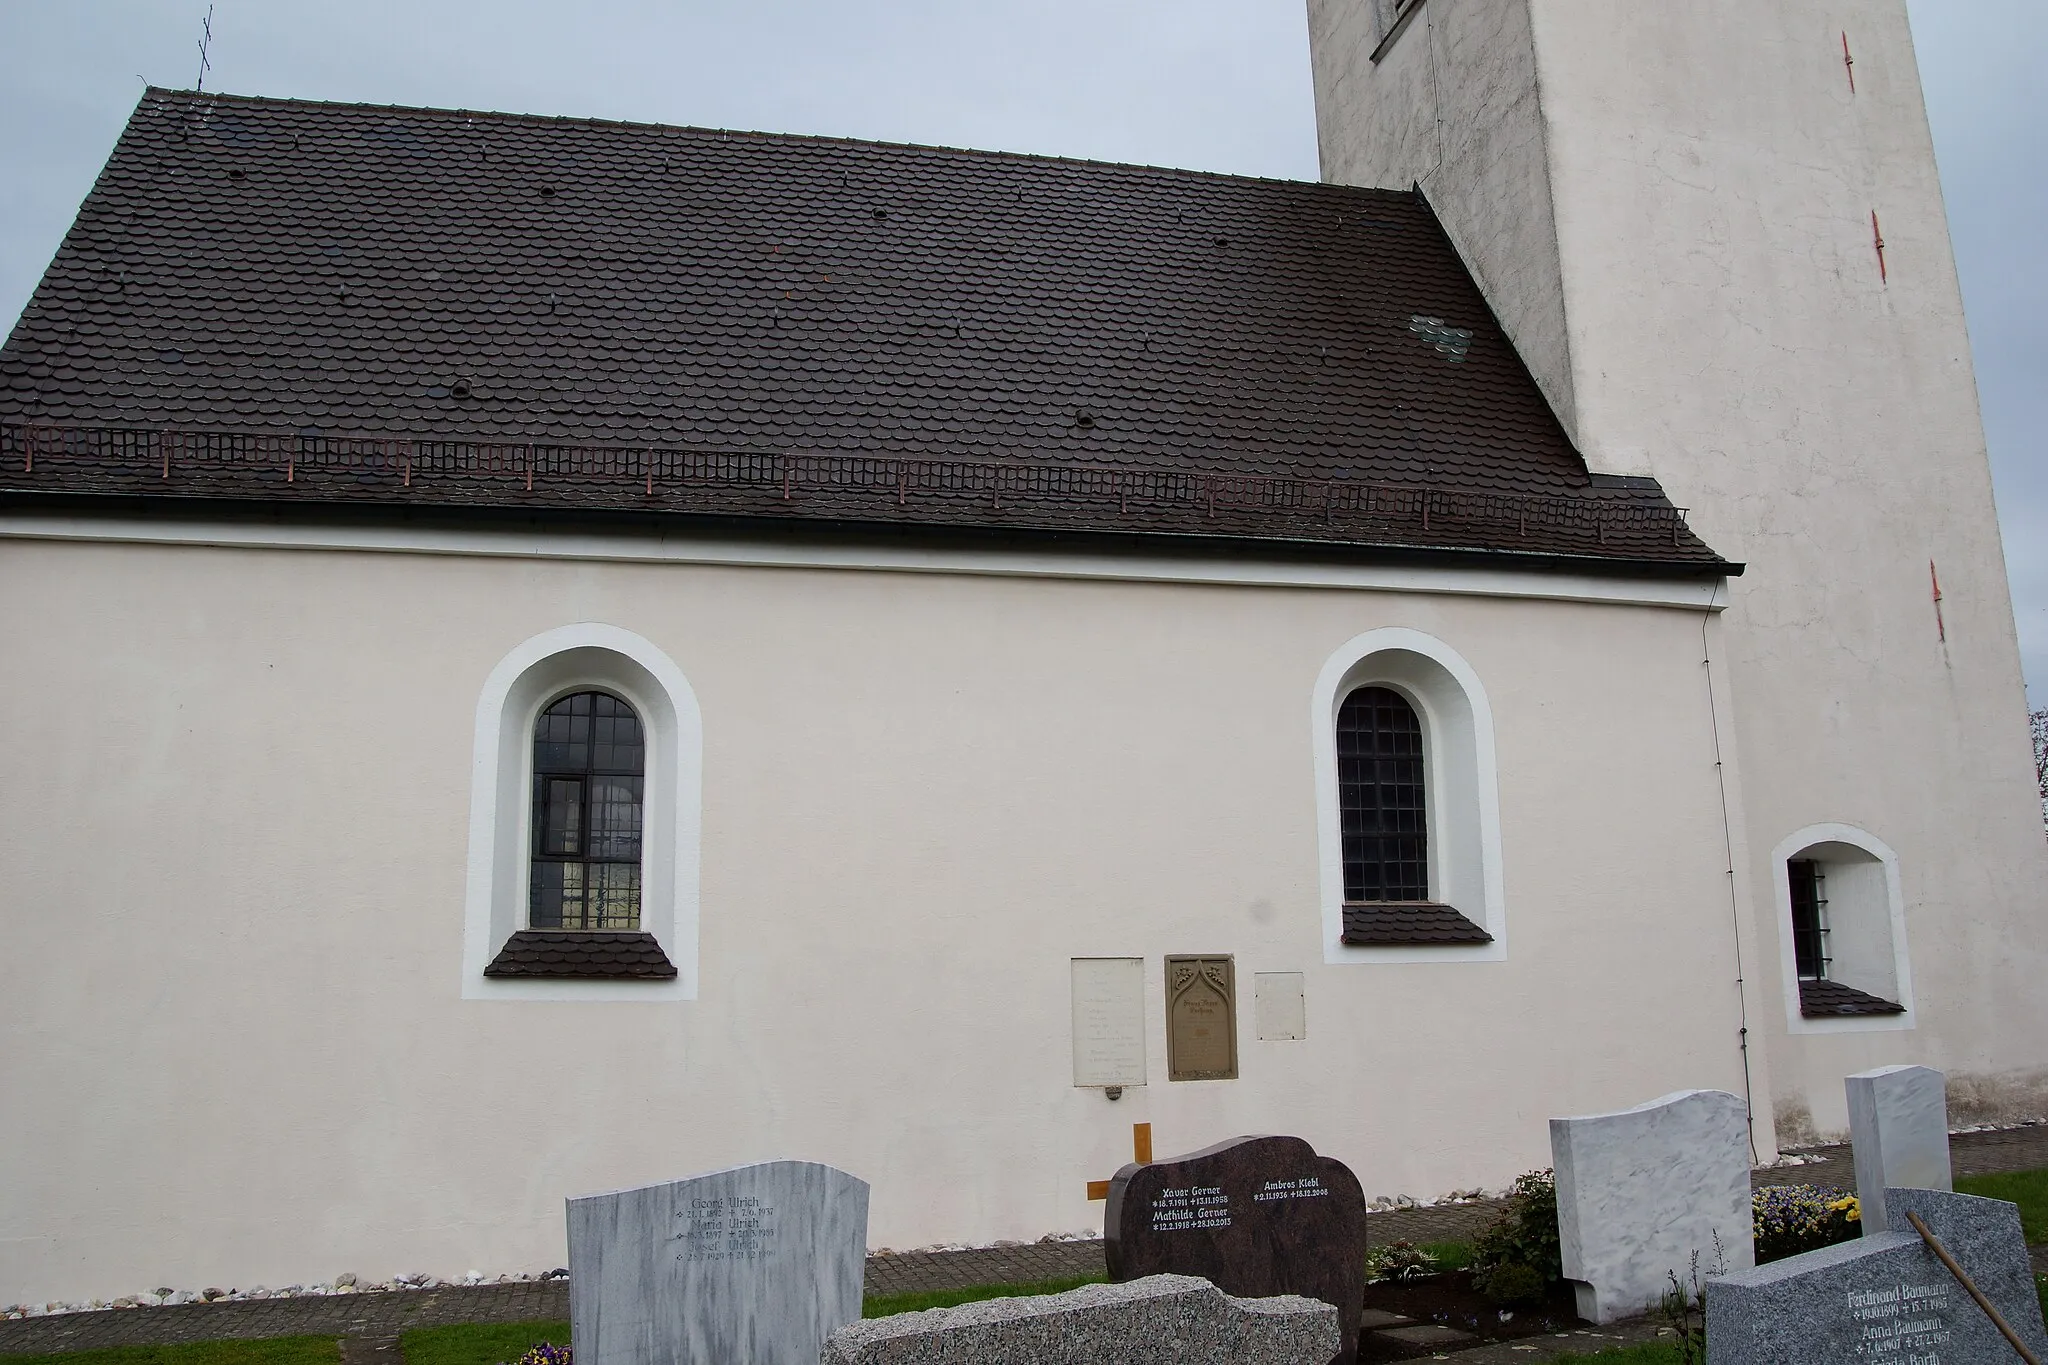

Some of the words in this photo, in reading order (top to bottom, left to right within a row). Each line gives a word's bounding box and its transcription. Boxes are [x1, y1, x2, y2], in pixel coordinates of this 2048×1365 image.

[1264, 1180, 1296, 1191] Ambros
[1298, 1177, 1319, 1188] Klebl
[1162, 1187, 1189, 1198] Xaver
[1191, 1186, 1221, 1196] Gerner
[691, 1198, 723, 1209] Georg
[728, 1196, 759, 1208] Ulrich
[1152, 1208, 1194, 1222] Mathilde
[1197, 1207, 1228, 1219] Gerner
[691, 1219, 722, 1230] Maria
[728, 1218, 759, 1229] Ulrich
[688, 1241, 720, 1252] Josef
[728, 1239, 758, 1250] Ulrich
[1847, 1285, 1900, 1308] Ferdinand
[1901, 1283, 1949, 1300] Baumann
[1862, 1324, 1892, 1340] Anna
[1894, 1317, 1943, 1336] Baumann
[1909, 1351, 1940, 1365] Barth
